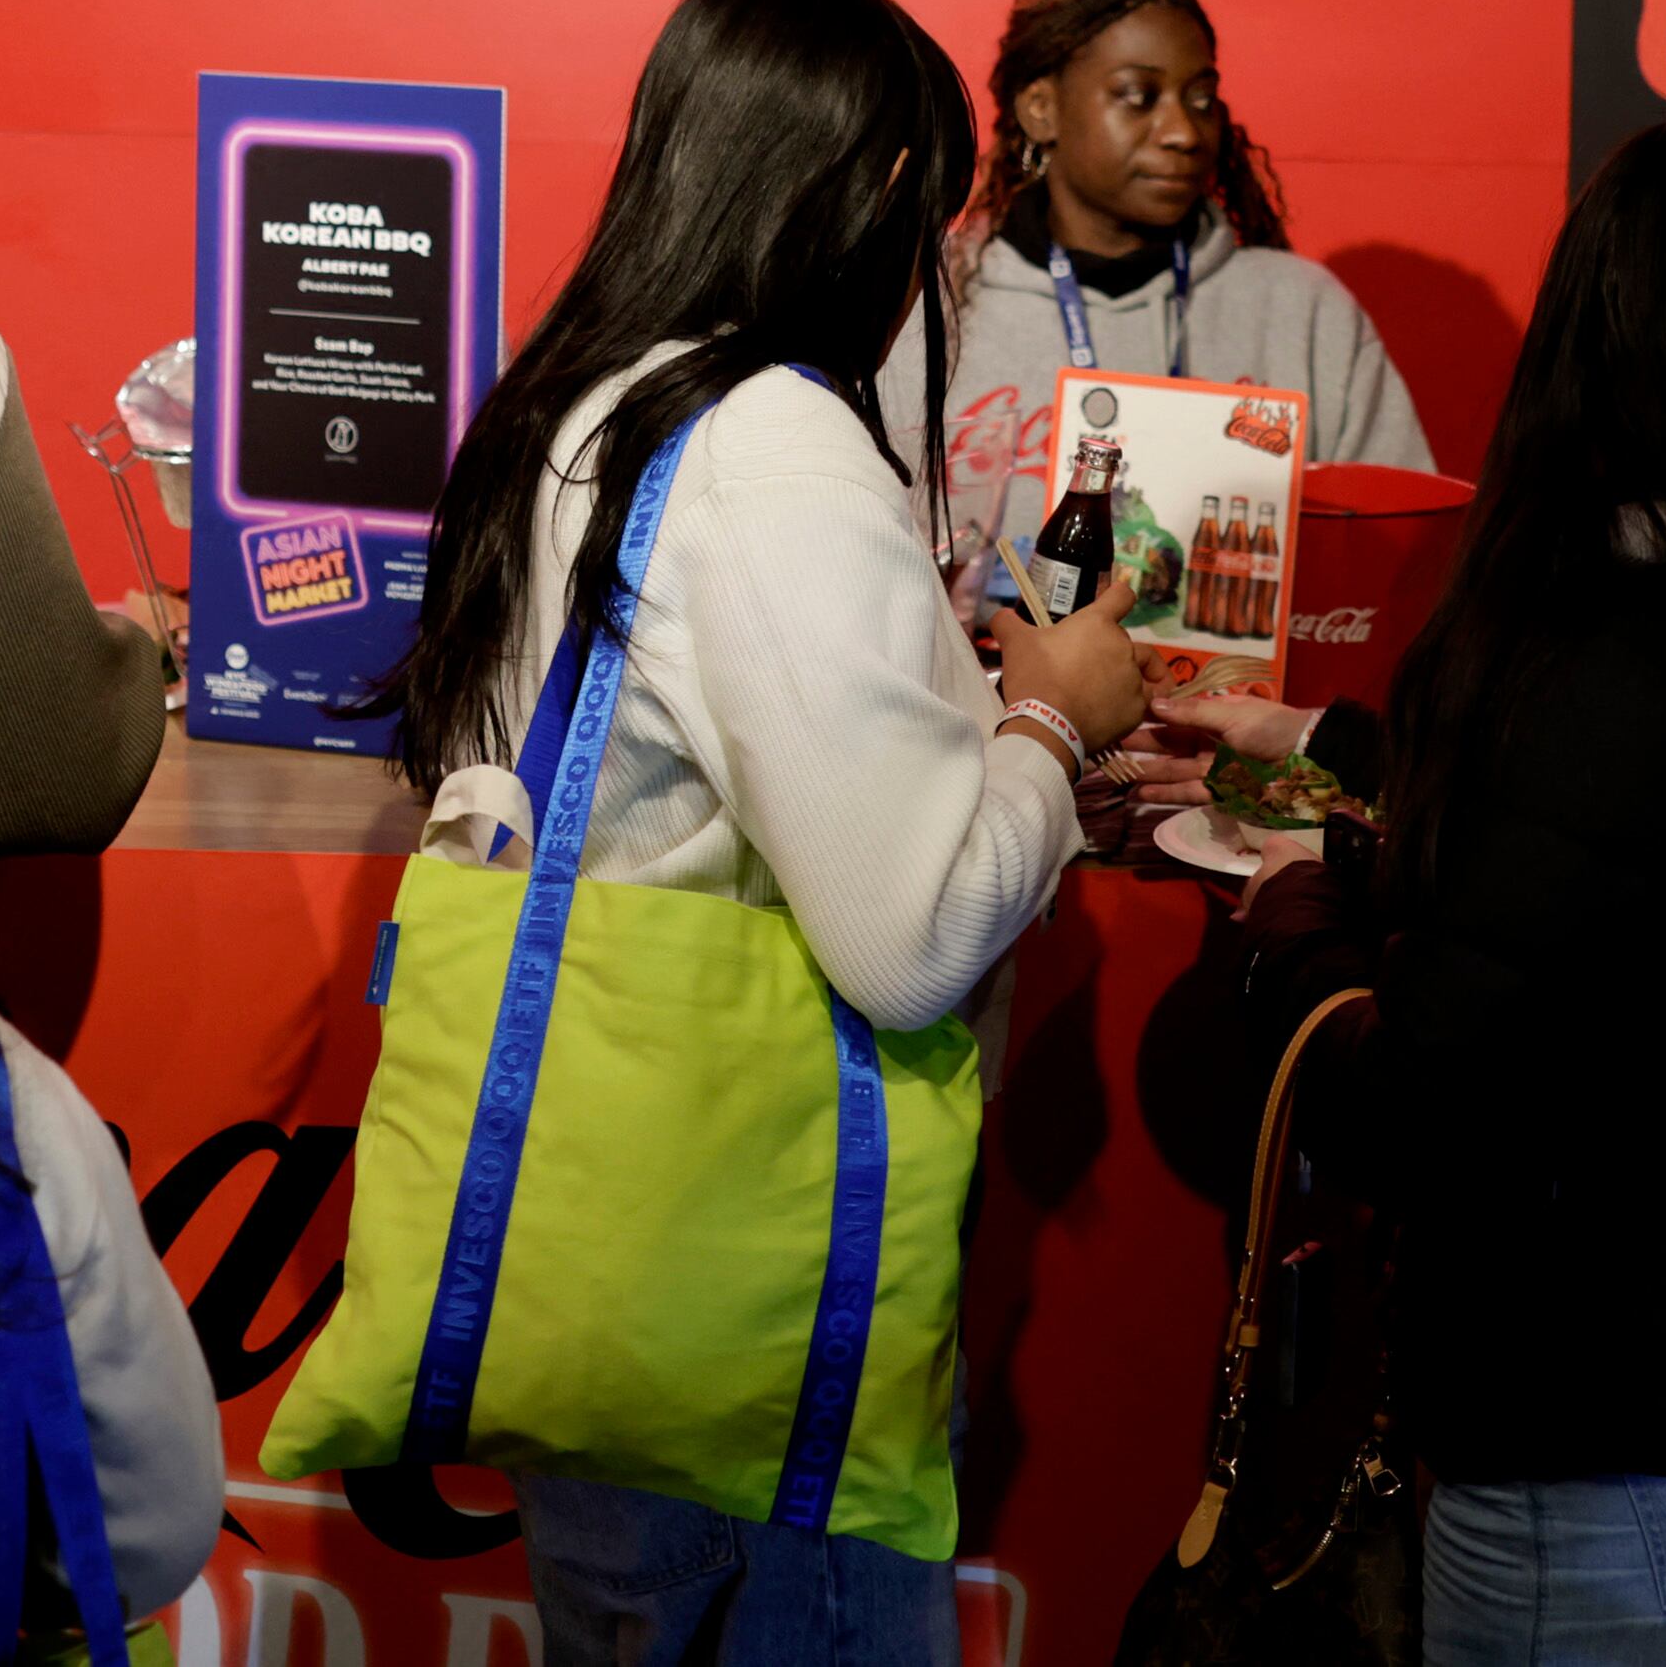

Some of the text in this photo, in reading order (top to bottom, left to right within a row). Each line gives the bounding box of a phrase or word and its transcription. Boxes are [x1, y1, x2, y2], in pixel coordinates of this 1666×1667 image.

[308, 201, 385, 227] KOBA
[261, 221, 432, 257] KOREAN BBQ
[301, 257, 358, 275] ALBERT
[257, 524, 342, 564] ASIAN
[259, 549, 346, 591] NIGHT
[265, 576, 353, 614] MARKET
[1288, 606, 1380, 644] ca-Cola
[437, 1149, 509, 1342] INVESCO
[483, 1042, 531, 1141] QQQ
[507, 960, 544, 1035] ETF
[577, 653, 616, 743] QQQ
